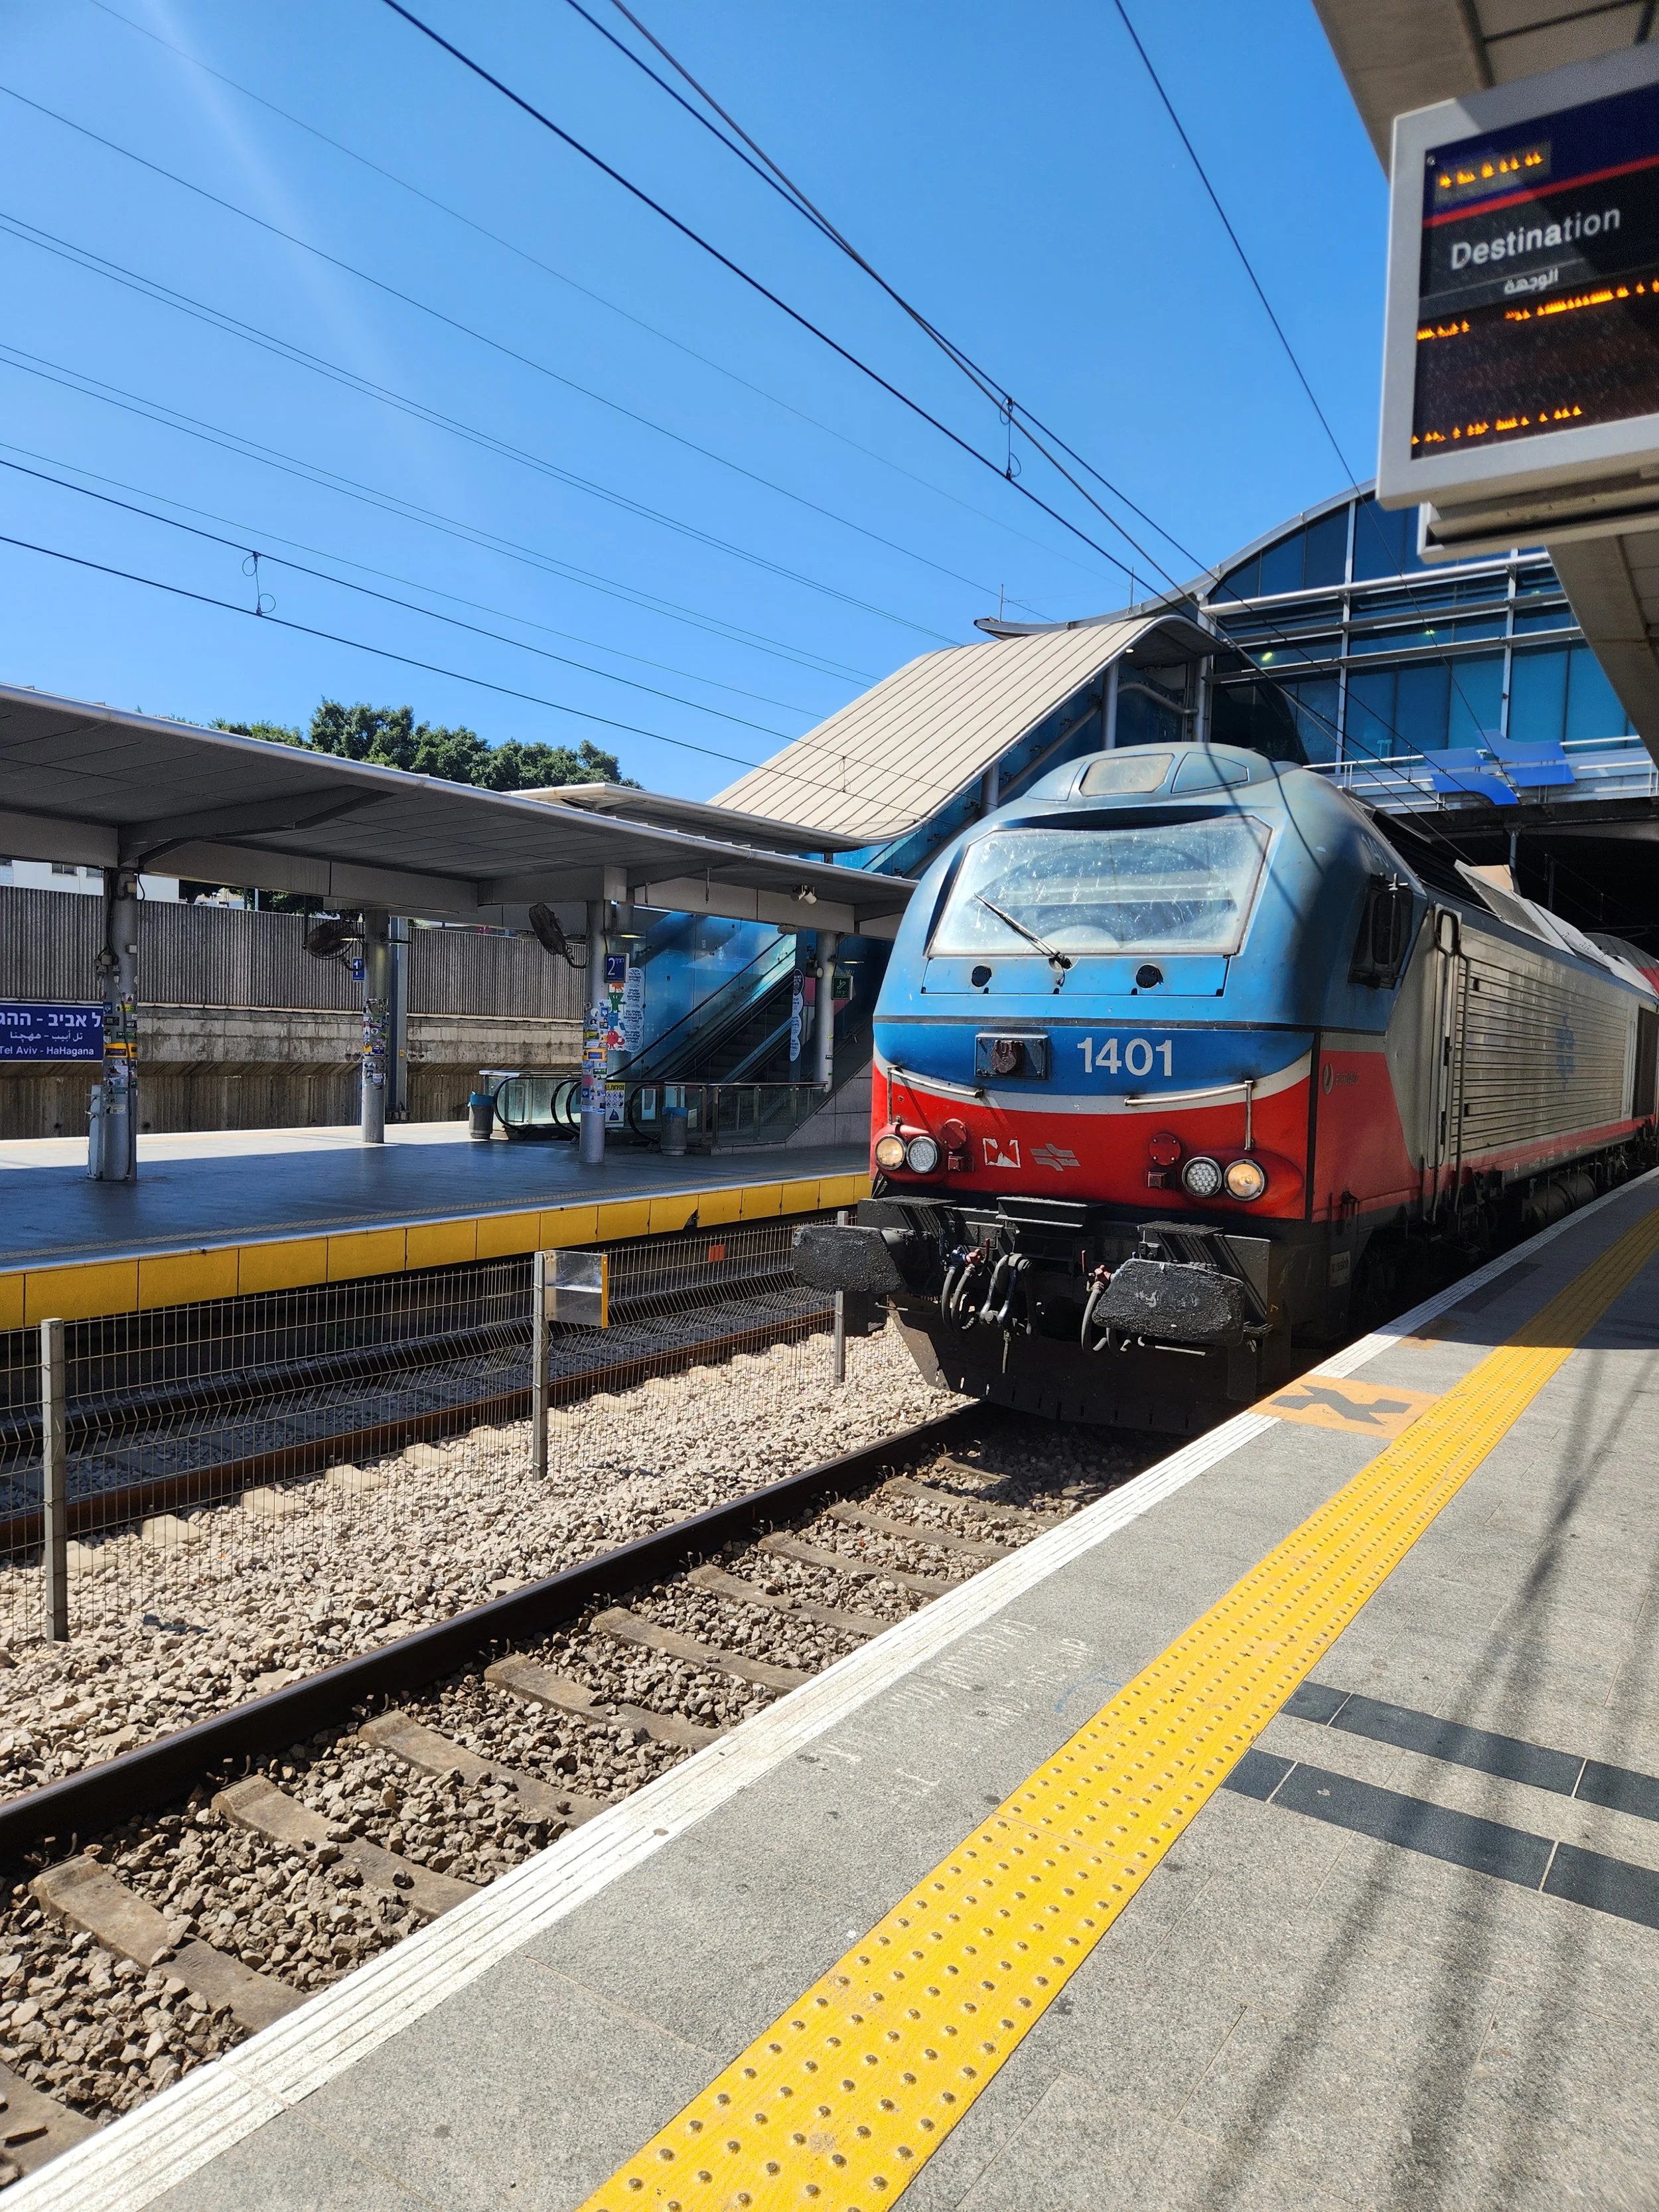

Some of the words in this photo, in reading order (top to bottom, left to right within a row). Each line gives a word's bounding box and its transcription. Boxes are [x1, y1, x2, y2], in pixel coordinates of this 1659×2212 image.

[1451, 208, 1621, 270] Destination
[1503, 267, 1559, 295] الوجهة
[607, 957, 615, 976] 2
[48, 1014, 87, 1027] אביב
[72, 1033, 83, 1042] تل
[0, 1046, 13, 1055] Tel
[16, 1046, 38, 1055] Aviv
[46, 1046, 94, 1057] HaHagana
[1077, 1037, 1172, 1076] 1401
